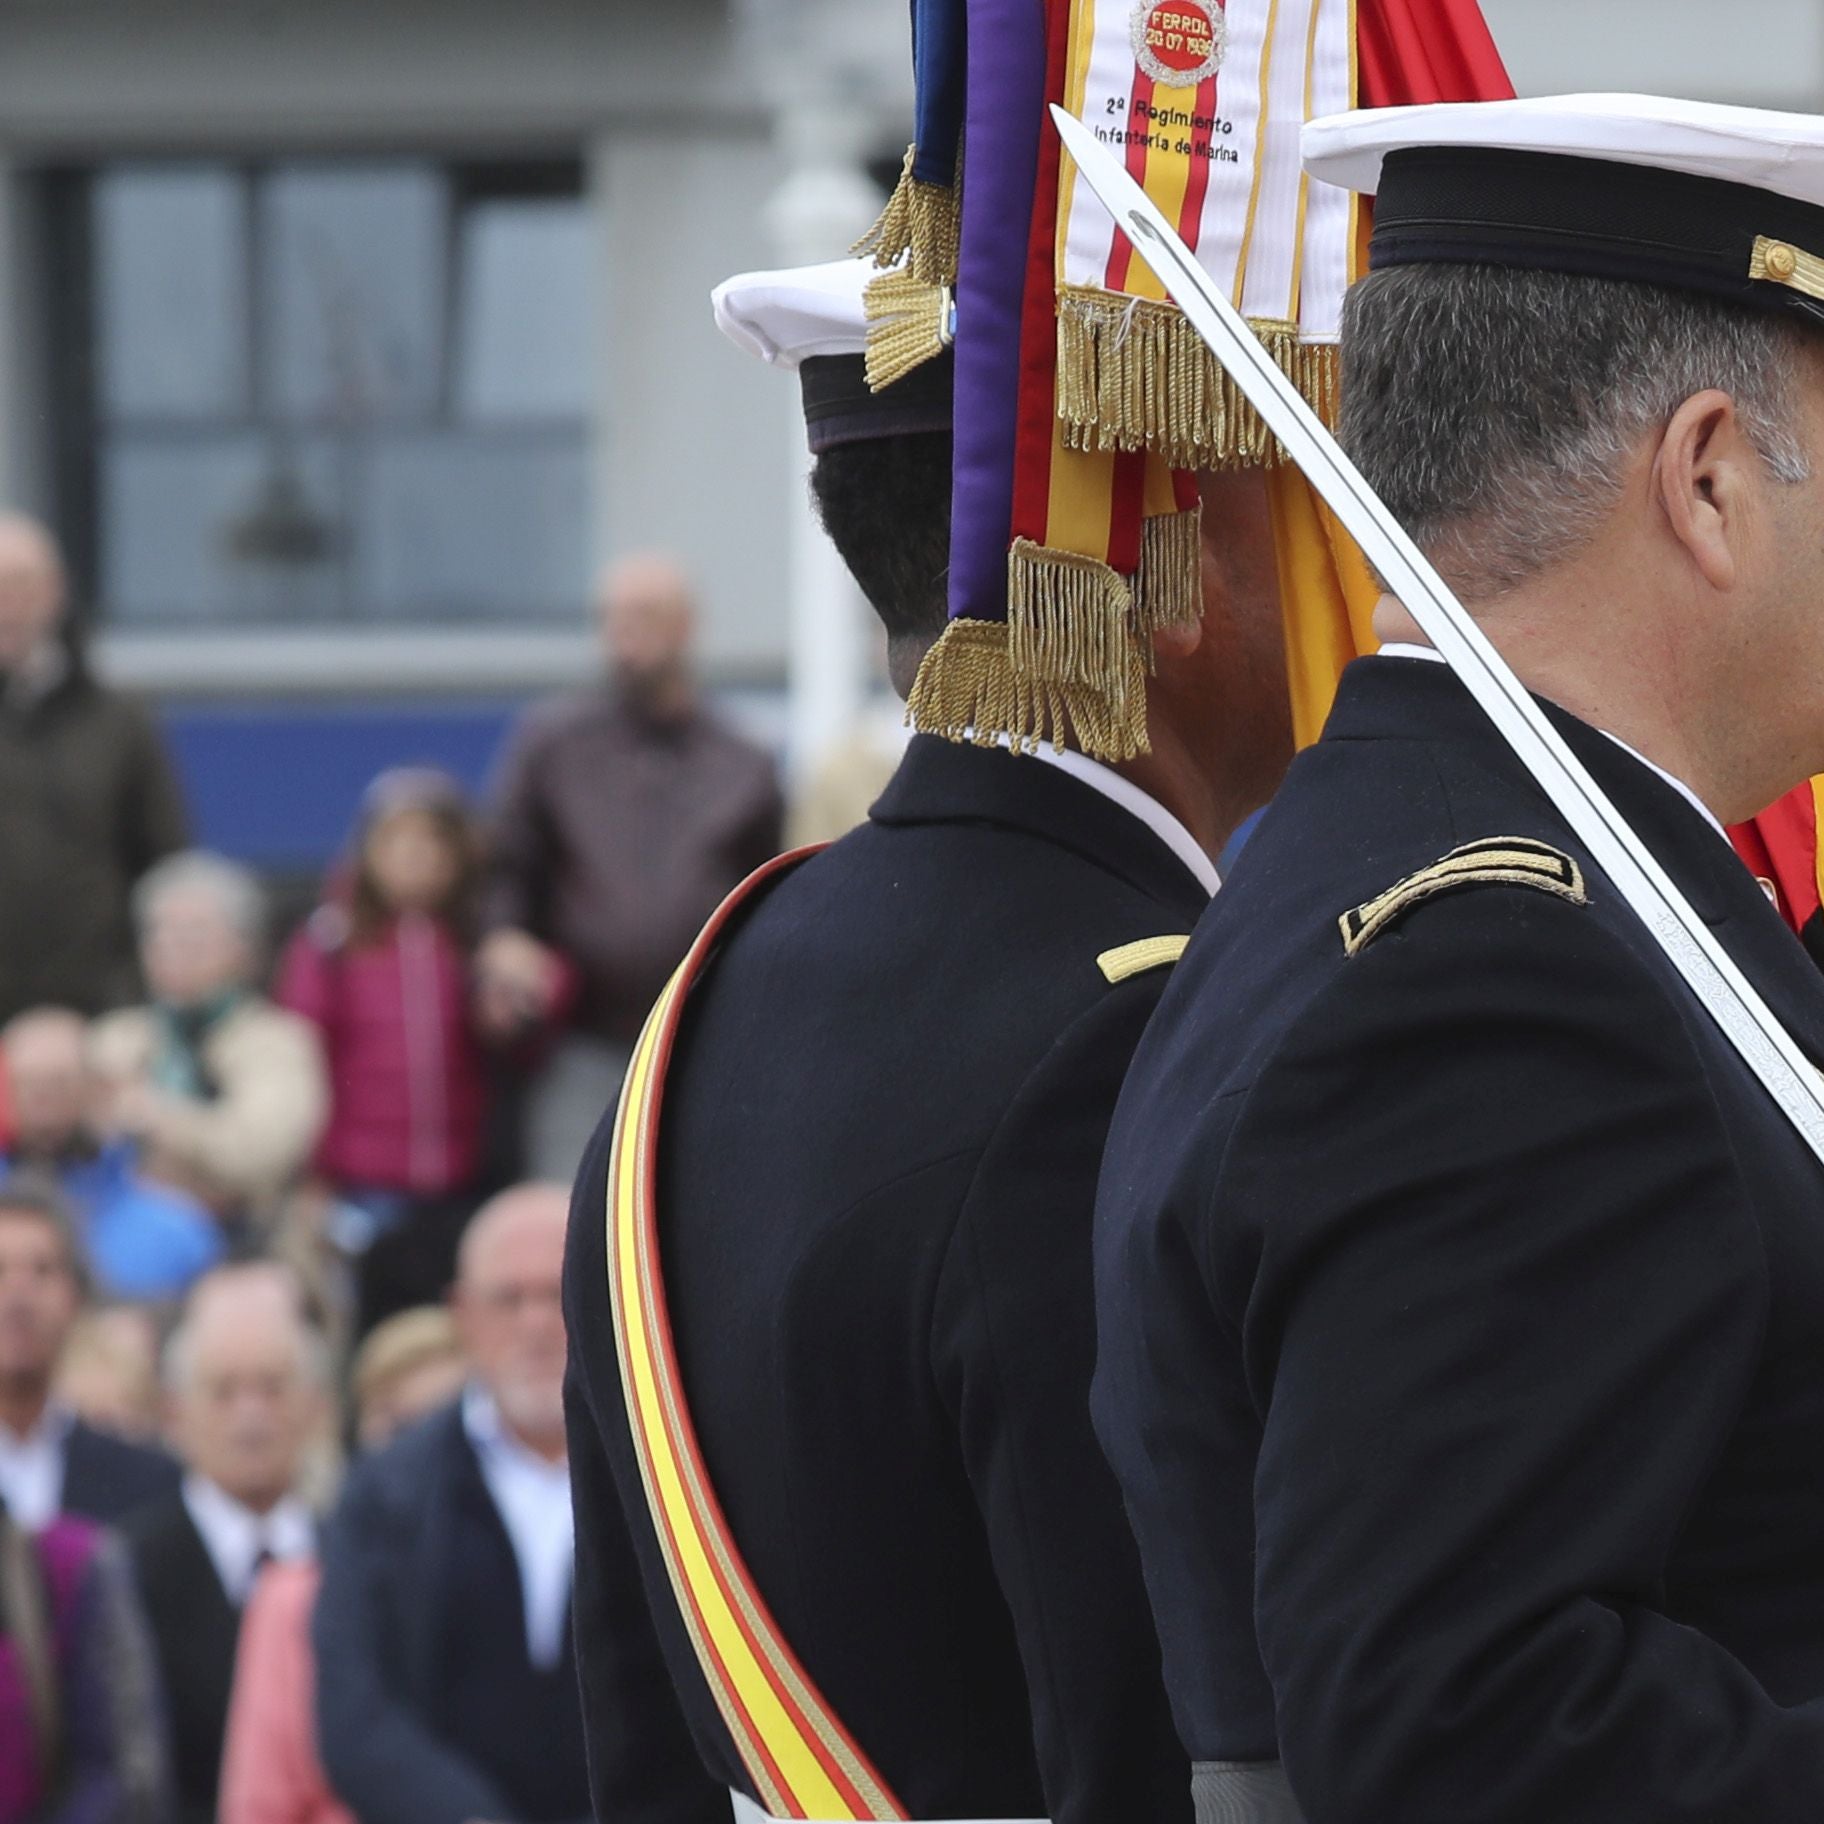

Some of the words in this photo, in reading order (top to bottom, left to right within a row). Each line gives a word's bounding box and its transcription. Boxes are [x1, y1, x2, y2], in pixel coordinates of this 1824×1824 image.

[1152, 11, 1210, 36] FERROL
[1145, 28, 1164, 46] 20
[1165, 32, 1183, 51] 07
[1135, 100, 1232, 134] Regimiento
[1175, 137, 1192, 154] de
[1195, 140, 1238, 163] Marina
